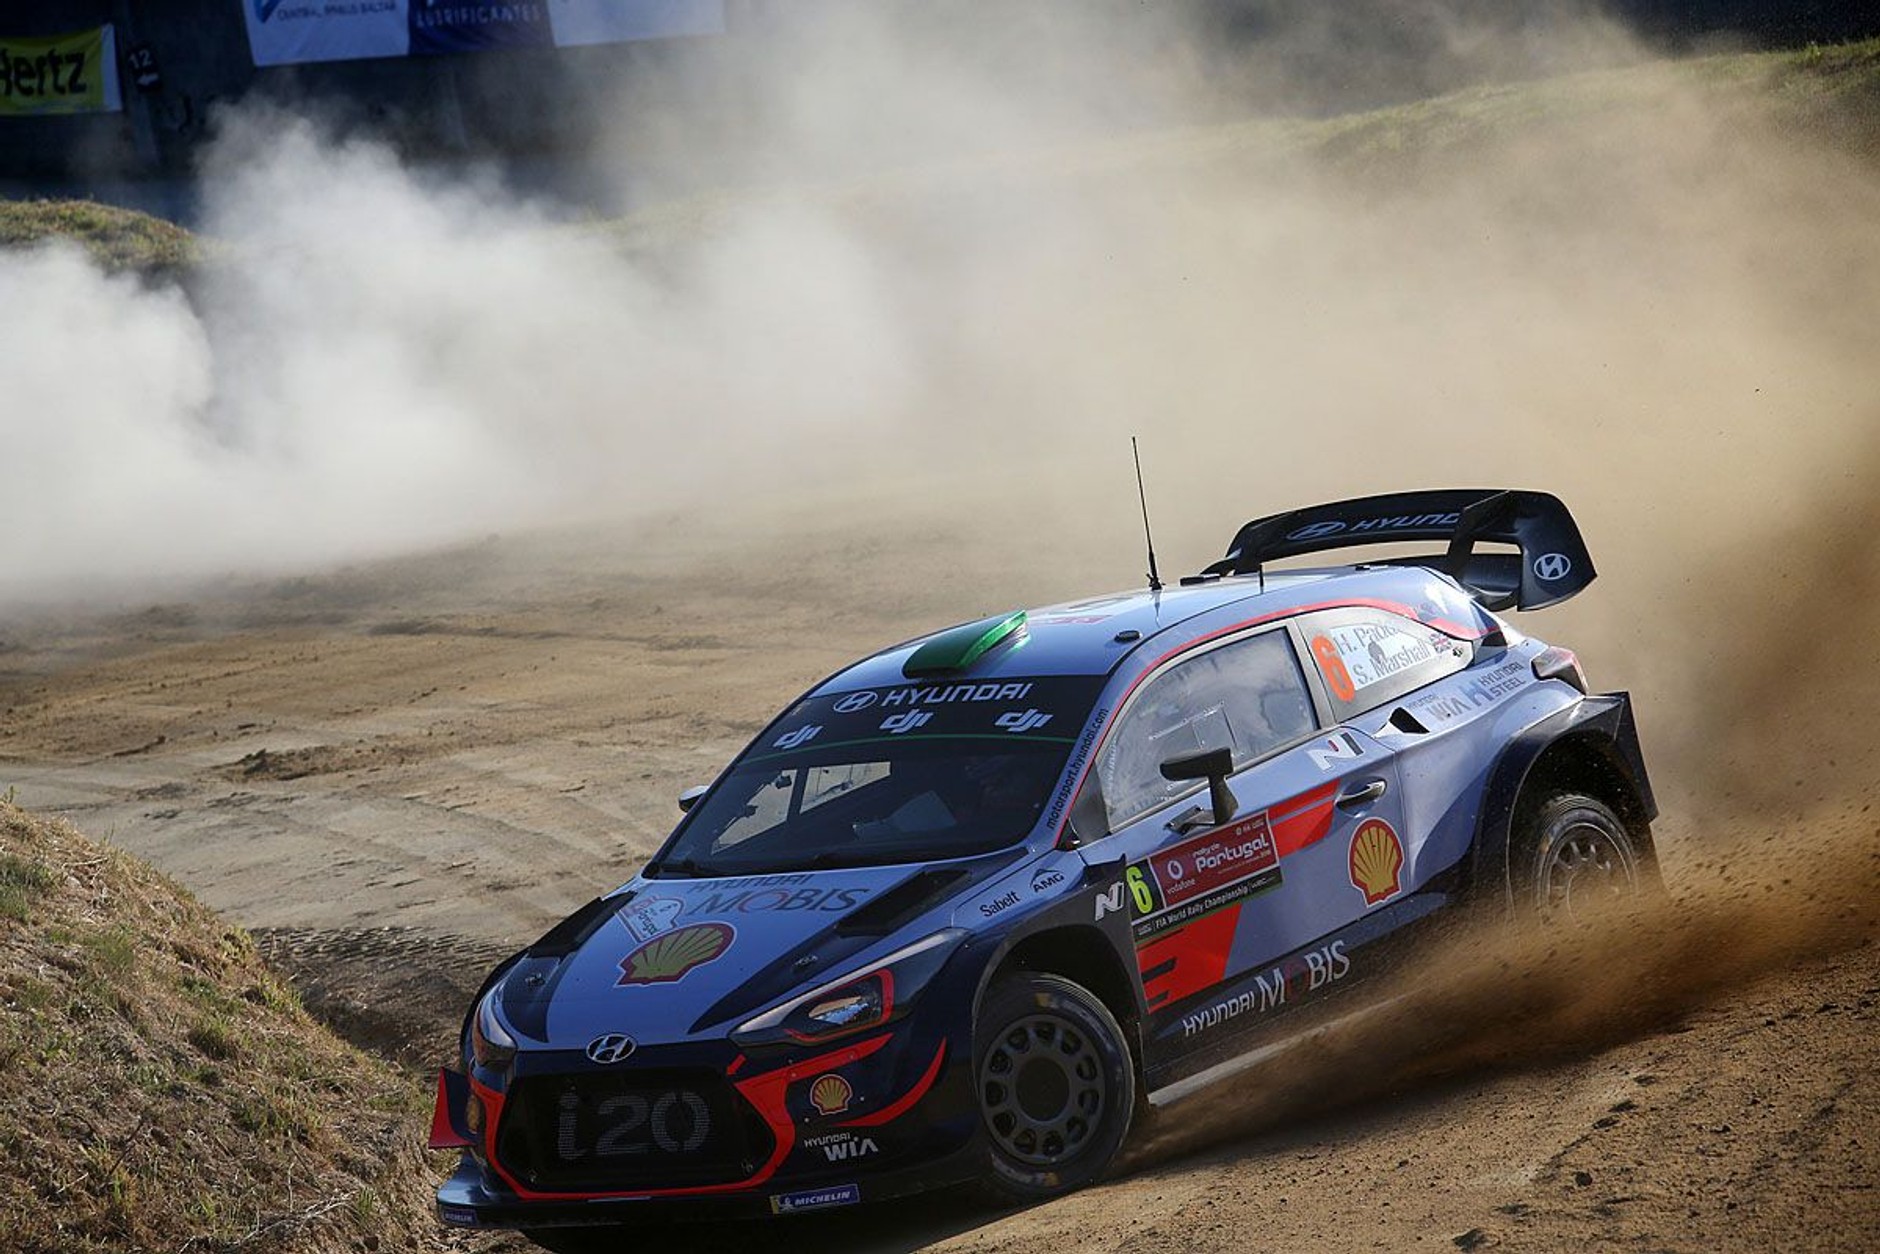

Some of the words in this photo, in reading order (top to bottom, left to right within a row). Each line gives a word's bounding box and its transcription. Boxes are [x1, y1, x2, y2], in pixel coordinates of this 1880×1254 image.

[129, 50, 152, 69] 12
[1351, 512, 1461, 532] HYUND
[1311, 633, 1355, 702] 6
[1369, 638, 1432, 677] Marshall
[1480, 661, 1525, 686] HYUNDAI
[881, 683, 1033, 707] HYUNDAI
[1492, 676, 1527, 697] STEEL
[1046, 708, 1109, 830] motorsport.hyundai.com
[1196, 833, 1269, 872] Portugal
[686, 873, 816, 896] HYUNDAI
[1033, 873, 1064, 893] AMG
[1126, 866, 1153, 914] 6
[1167, 878, 1196, 895] vodafone
[688, 888, 870, 916] MOBIS
[979, 890, 1021, 917] Sabelt
[1168, 907, 1187, 924] World
[1188, 902, 1204, 917] Rally
[1204, 885, 1248, 909] Championship
[1182, 991, 1255, 1037] HYUNDAI
[1254, 940, 1350, 1012] MOBIS
[557, 1088, 711, 1161] i20
[803, 1132, 850, 1148] HYUNDAI
[824, 1136, 878, 1161] WIA
[795, 1190, 851, 1206] MICHELIN
